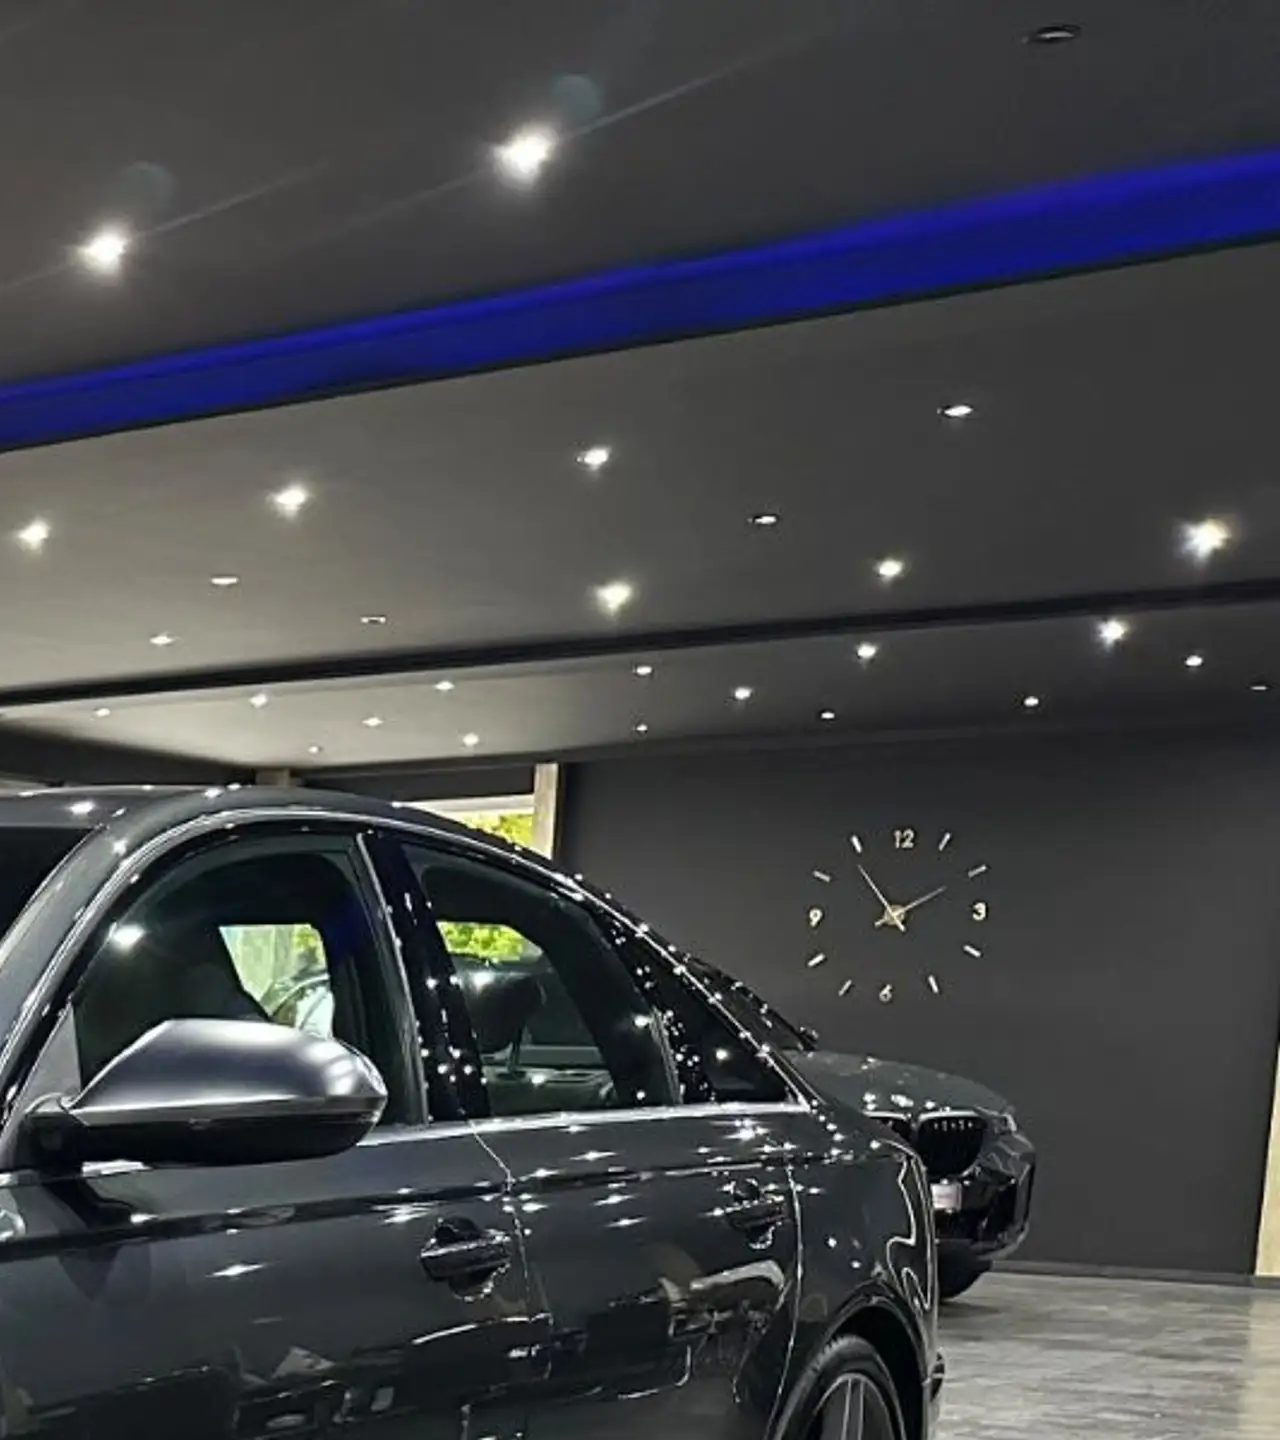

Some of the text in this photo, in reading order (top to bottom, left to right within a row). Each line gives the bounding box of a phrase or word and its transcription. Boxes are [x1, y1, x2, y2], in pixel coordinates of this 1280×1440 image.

[893, 828, 915, 849] 12
[808, 907, 824, 928] 9
[972, 902, 988, 922] 3
[878, 984, 893, 1003] 6
